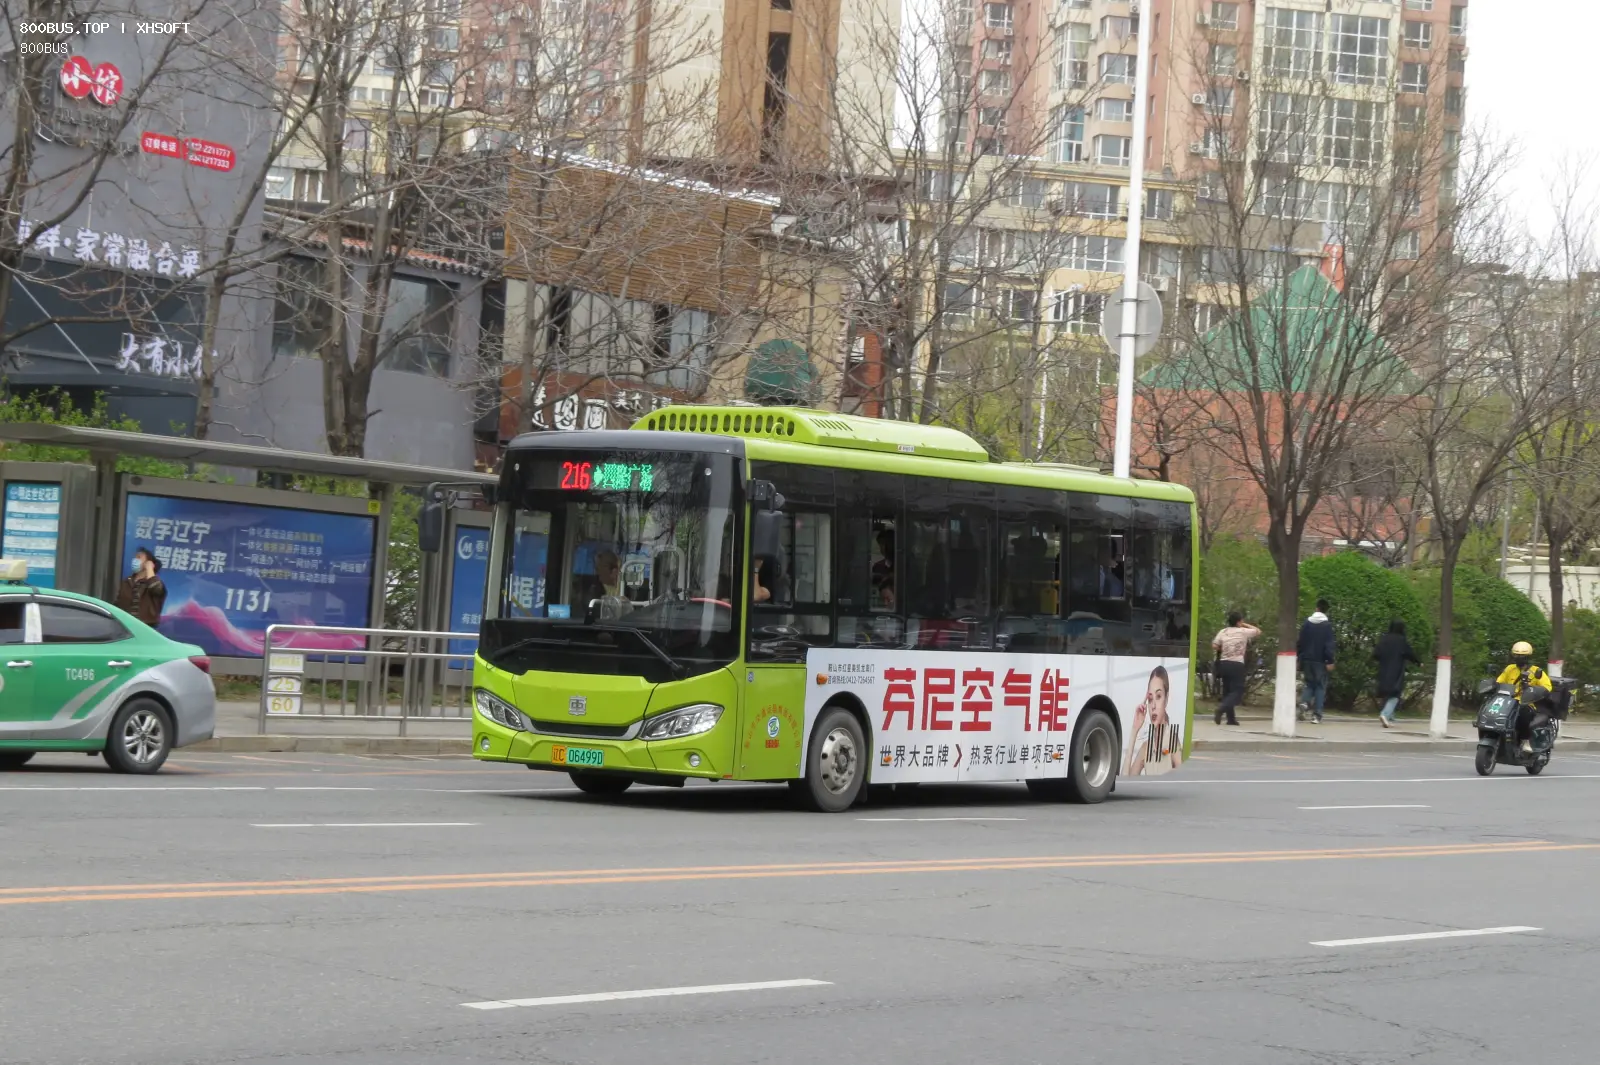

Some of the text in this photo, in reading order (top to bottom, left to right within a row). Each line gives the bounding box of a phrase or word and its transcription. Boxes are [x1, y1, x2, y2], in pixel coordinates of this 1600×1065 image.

[560, 461, 593, 490] 216
[134, 517, 211, 545] 数字辽宁
[155, 545, 228, 574] 智链未来
[224, 587, 271, 613] 1131
[64, 667, 95, 681] TC496
[271, 697, 294, 713] 60
[881, 667, 1070, 732] 芬尼空气能
[880, 744, 949, 769] 世界大品牌
[969, 743, 1066, 766] 热泵行业单项冠军
